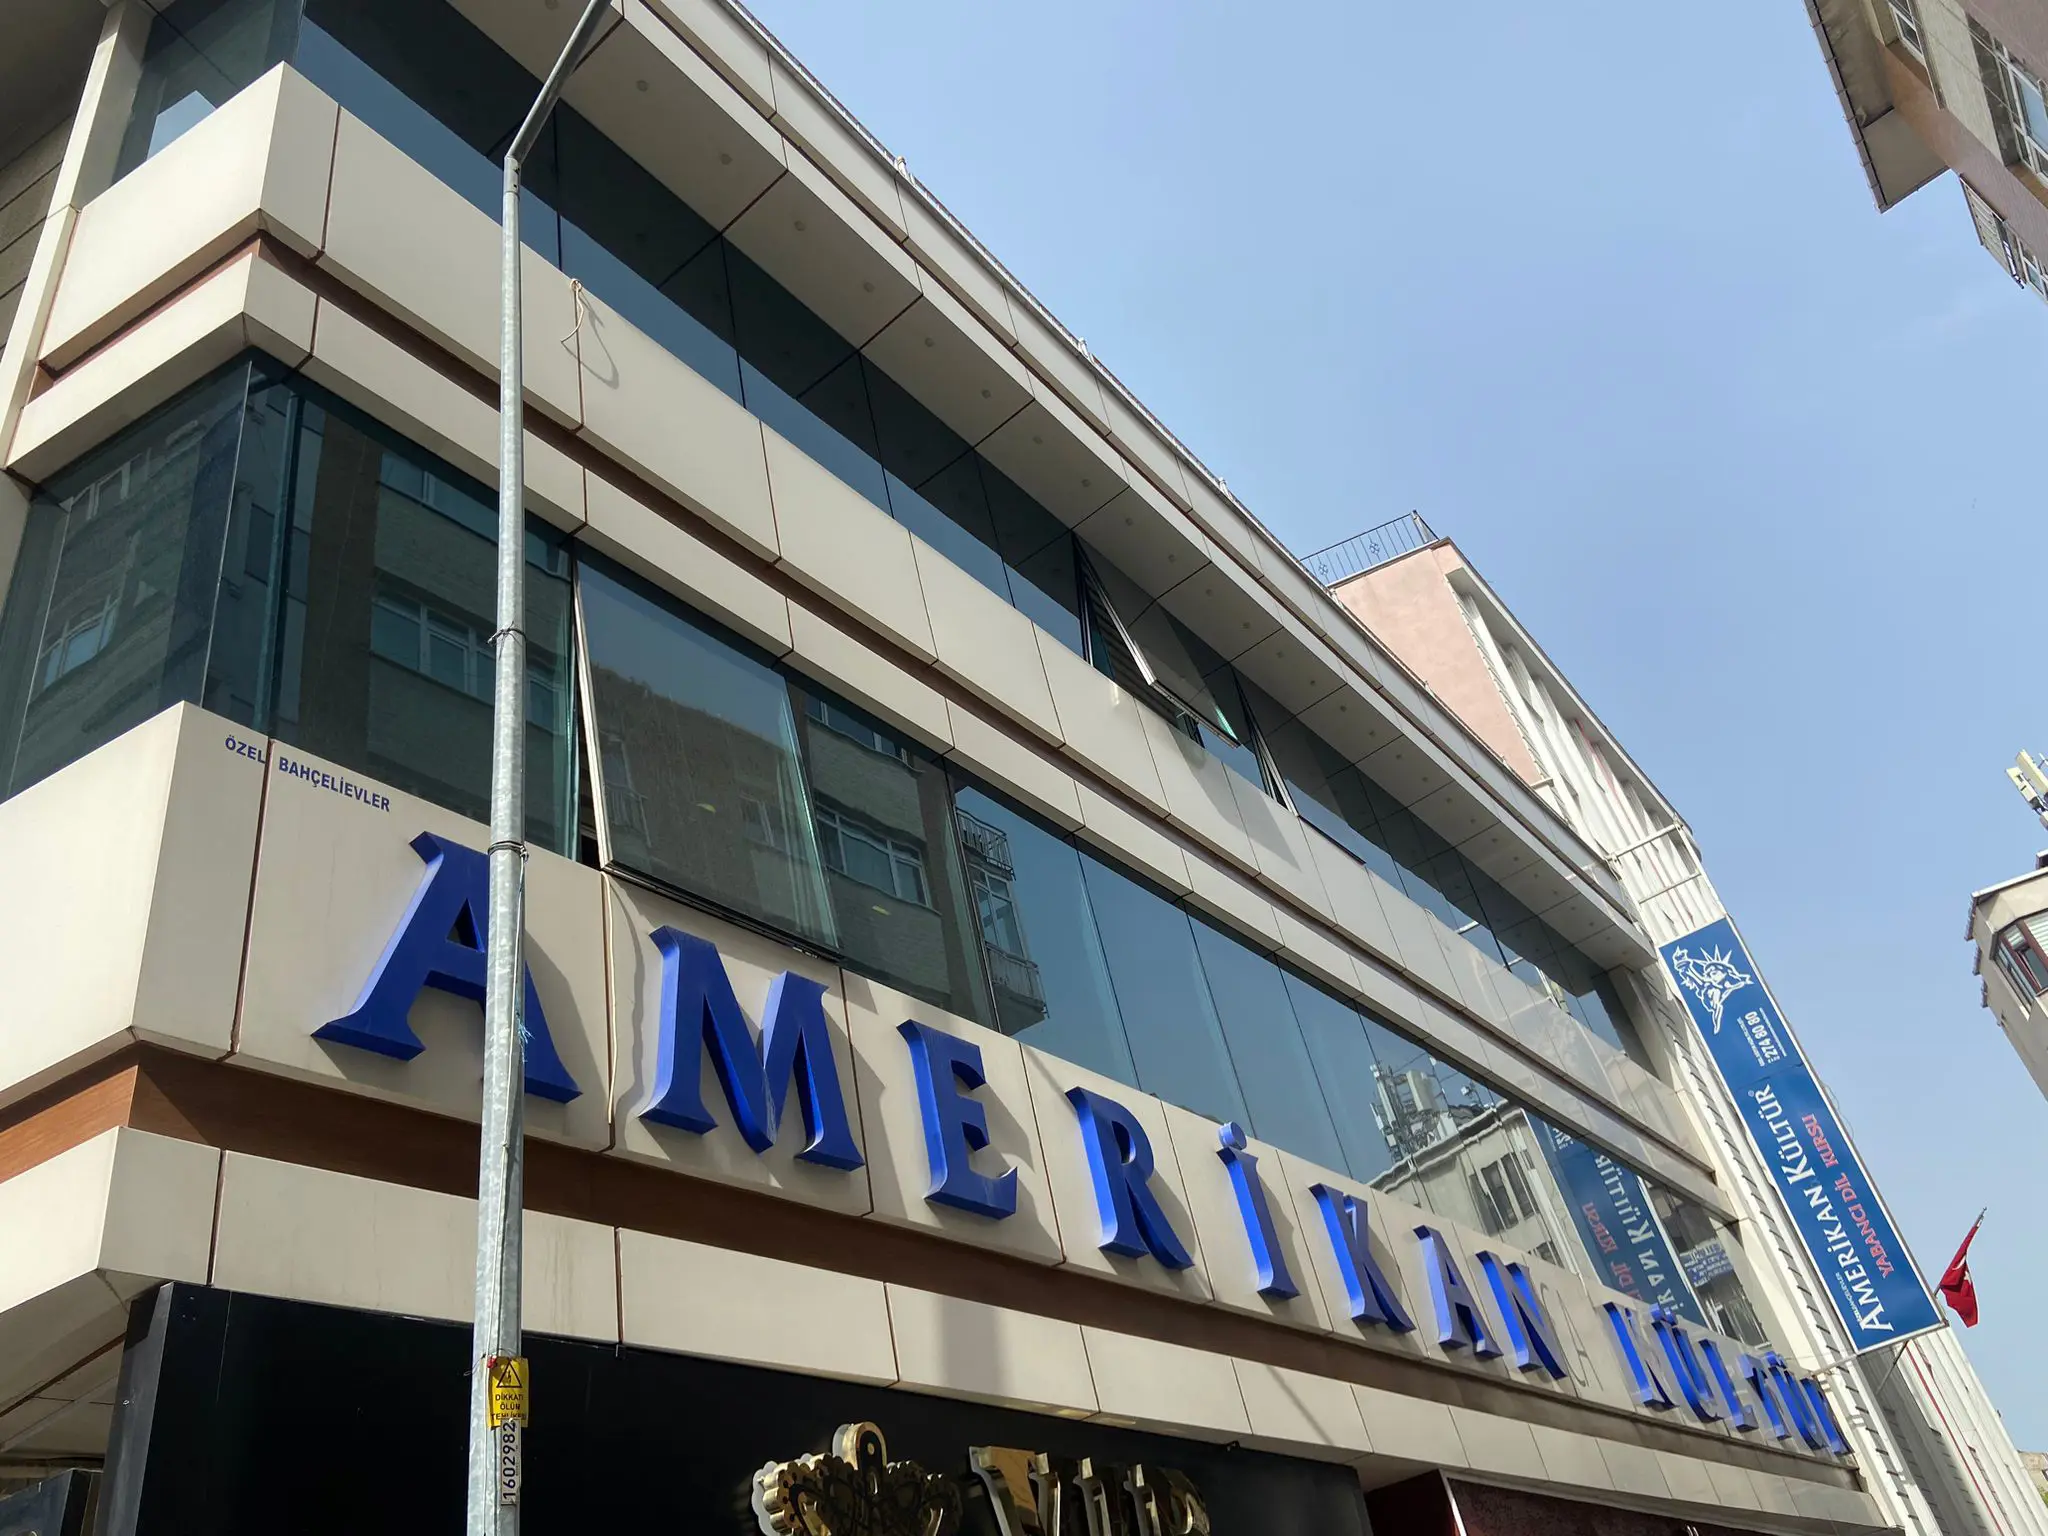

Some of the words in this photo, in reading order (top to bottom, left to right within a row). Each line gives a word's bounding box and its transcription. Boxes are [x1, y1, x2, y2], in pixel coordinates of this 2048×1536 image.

[225, 735, 266, 764] ÖZEL
[278, 756, 390, 812] BAHÇELİEVLER
[1744, 1011, 1761, 1026] 80
[1751, 1025, 1768, 1040] 80
[1758, 1038, 1779, 1059] 274
[311, 831, 1568, 1381] AMERİKAN
[1602, 1301, 1855, 1456] KÜLTÜR
[1755, 1083, 1816, 1185] KÜLTÜR
[1801, 1113, 1840, 1168] KURSU
[1834, 1172, 1858, 1203] DİL
[1803, 1184, 1894, 1332] AMERİKAN
[1848, 1203, 1895, 1279] YABANCI
[502, 1421, 516, 1500] 1602982
